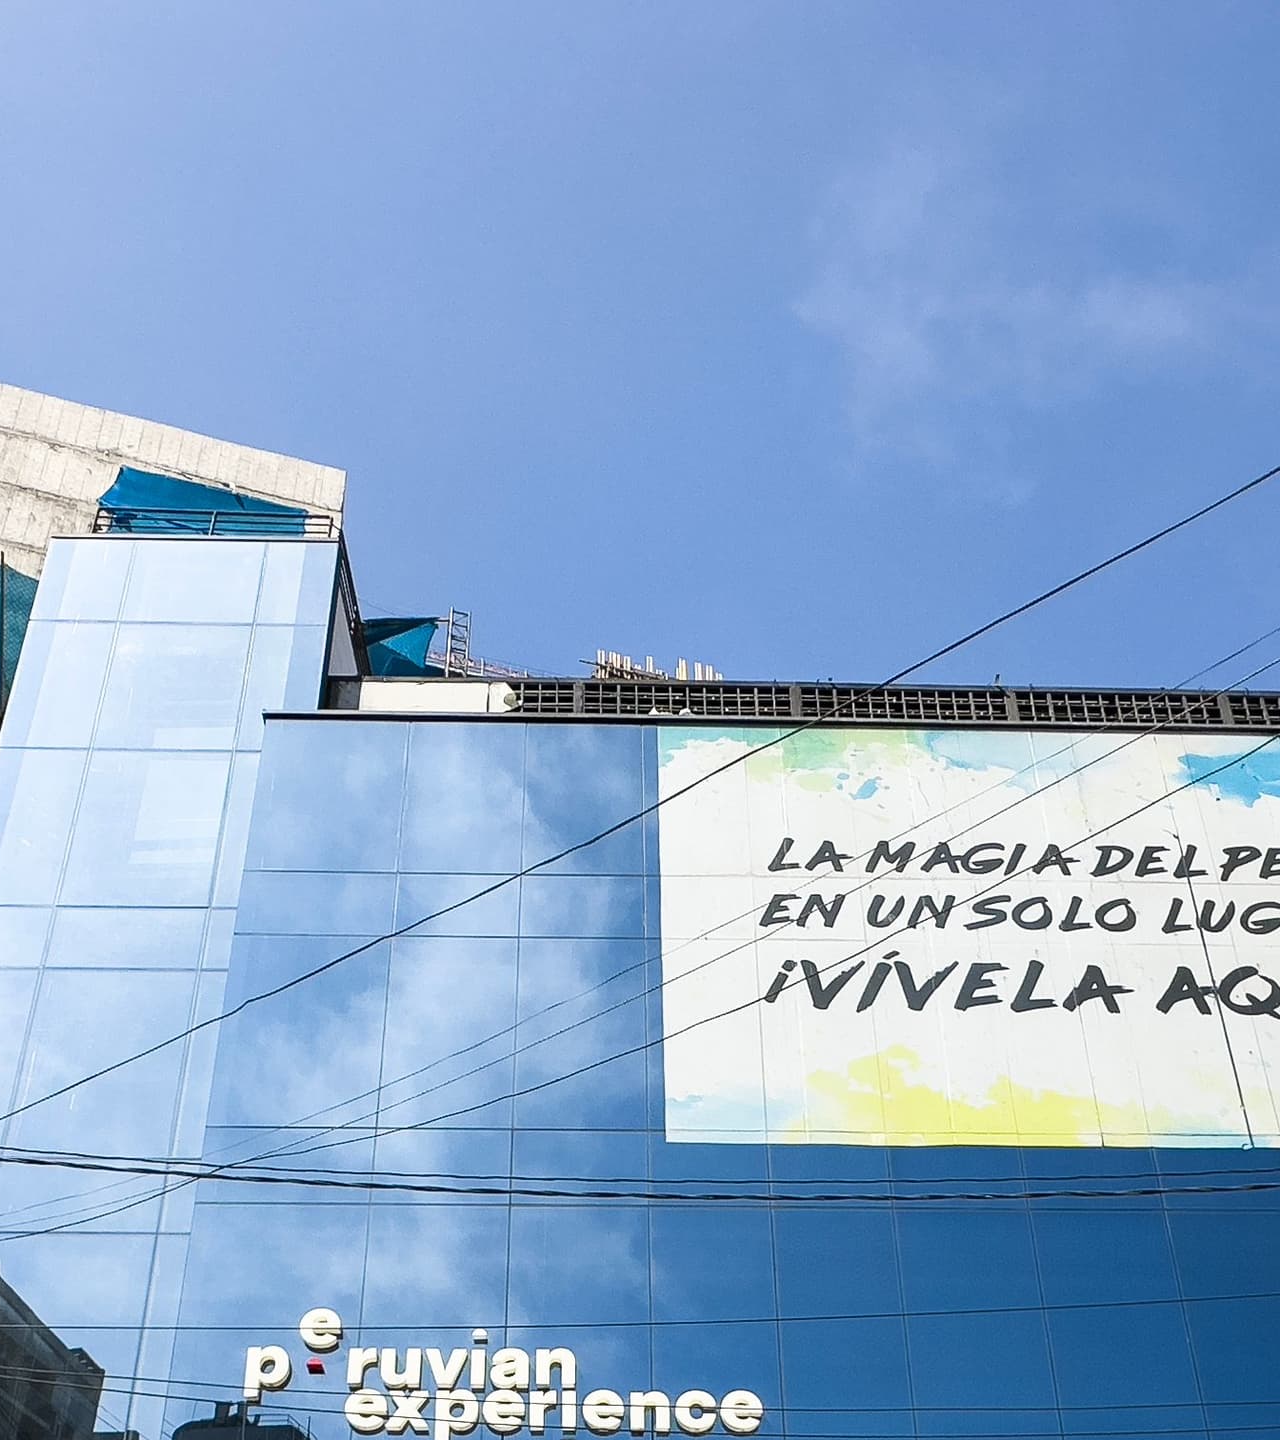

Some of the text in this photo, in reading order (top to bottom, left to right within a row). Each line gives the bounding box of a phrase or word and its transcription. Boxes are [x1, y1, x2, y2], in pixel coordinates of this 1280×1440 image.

[767, 838, 851, 876] LA
[865, 841, 1080, 878] MAGIA
[1090, 844, 1206, 880] DEL
[759, 893, 846, 930] EN
[865, 894, 955, 930] UN
[963, 895, 1138, 934] SOLO
[764, 949, 1136, 1016] ¡VÍVELA
[243, 1307, 577, 1400] peruvian
